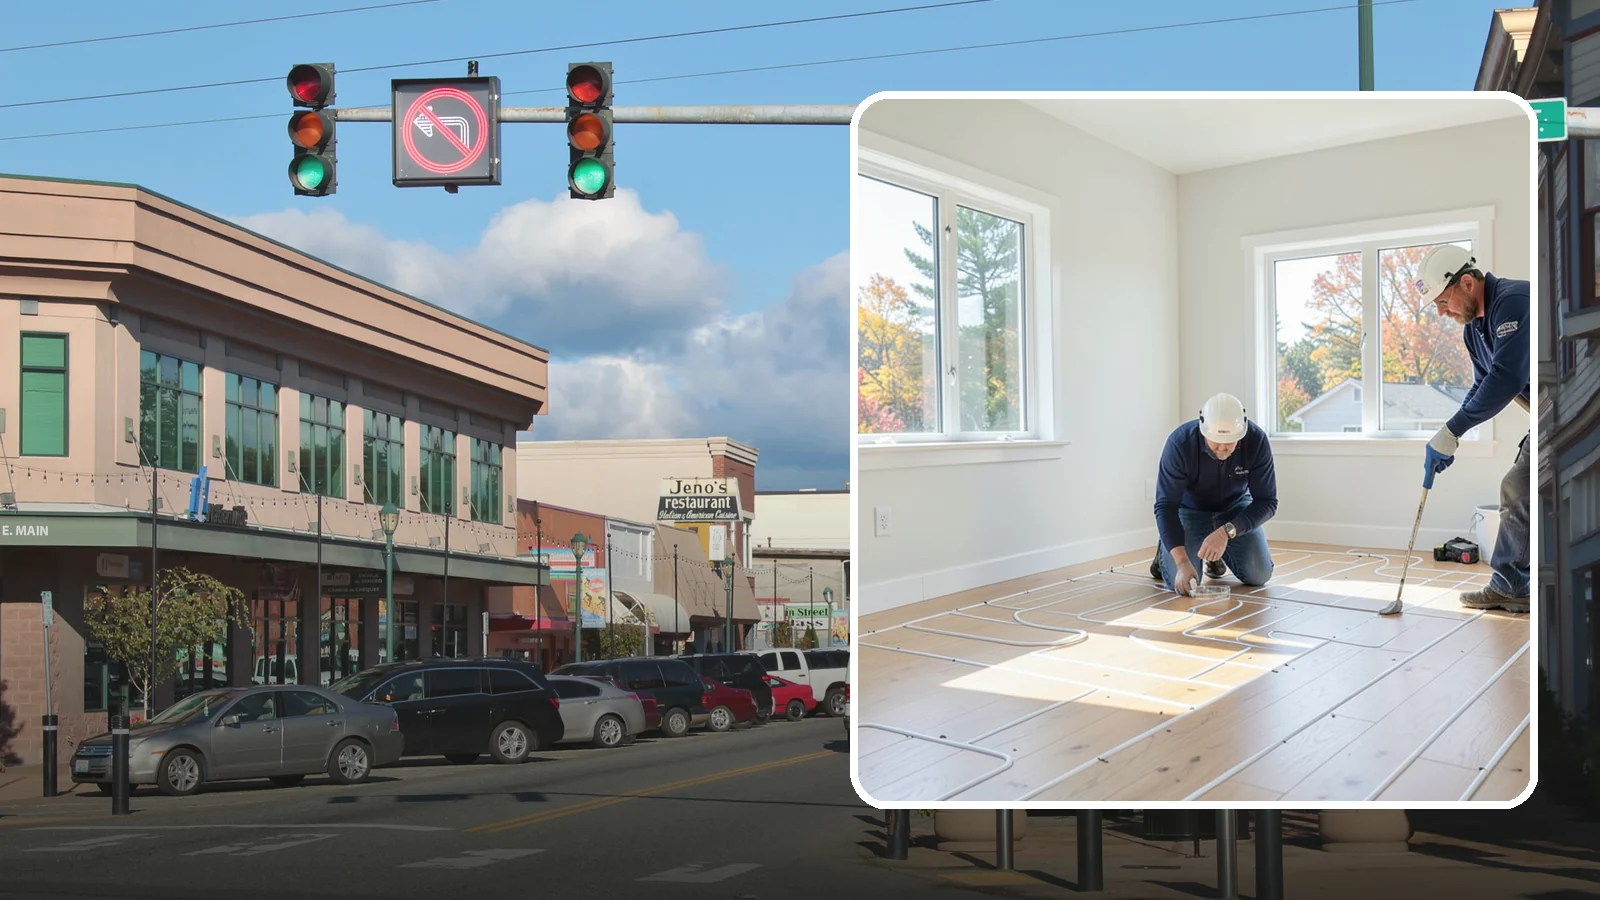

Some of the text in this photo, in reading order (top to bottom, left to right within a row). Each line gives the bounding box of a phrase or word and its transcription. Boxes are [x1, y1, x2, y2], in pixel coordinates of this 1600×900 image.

[669, 480, 727, 494] Jeno's
[665, 496, 731, 509] restaurant
[658, 510, 681, 520] Italian
[686, 509, 714, 519] American
[715, 509, 737, 519] Cuisine
[2, 525, 49, 536] E. MAIN
[797, 608, 828, 616] Street
[791, 619, 823, 627] lass
